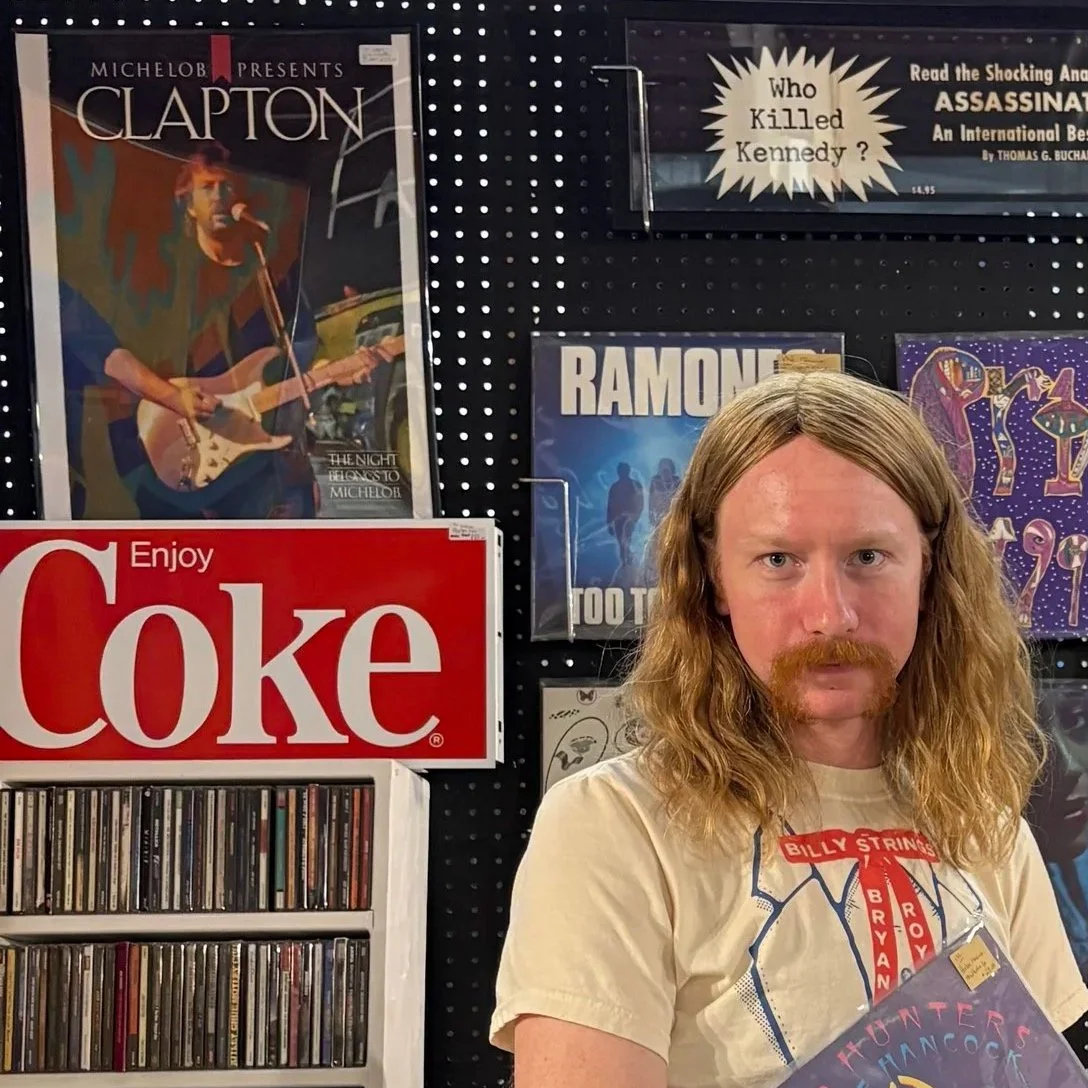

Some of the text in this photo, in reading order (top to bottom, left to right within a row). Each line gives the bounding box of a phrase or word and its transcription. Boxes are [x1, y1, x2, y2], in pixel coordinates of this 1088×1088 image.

[90, 62, 344, 78] MICHELOB PRESENTS
[910, 64, 949, 82] Read
[955, 64, 980, 82] the
[986, 63, 1053, 86] Shocking
[768, 77, 818, 99] Who
[76, 85, 365, 142] CLAPTON
[749, 108, 844, 130] Killed
[932, 124, 953, 142] An
[960, 124, 1060, 142] International
[735, 141, 847, 168] Kennedy
[982, 150, 994, 162] By
[997, 150, 1038, 161] THOMAS
[1041, 150, 1052, 161] G.
[560, 346, 816, 416] RAMON
[328, 453, 400, 466] THE NIGHT
[328, 470, 400, 482] BELONGS TO
[330, 487, 402, 499] MICHELOB
[130, 541, 215, 573] Enjoy
[570, 587, 624, 625] TOO
[0, 538, 442, 750] Coke
[785, 836, 936, 858] BILLY STRINGS
[866, 889, 890, 991] BRYAN
[901, 902, 928, 961] ROY
[836, 1001, 1031, 1076] HUNTERS
[877, 1032, 1023, 1082] HANCOCK
